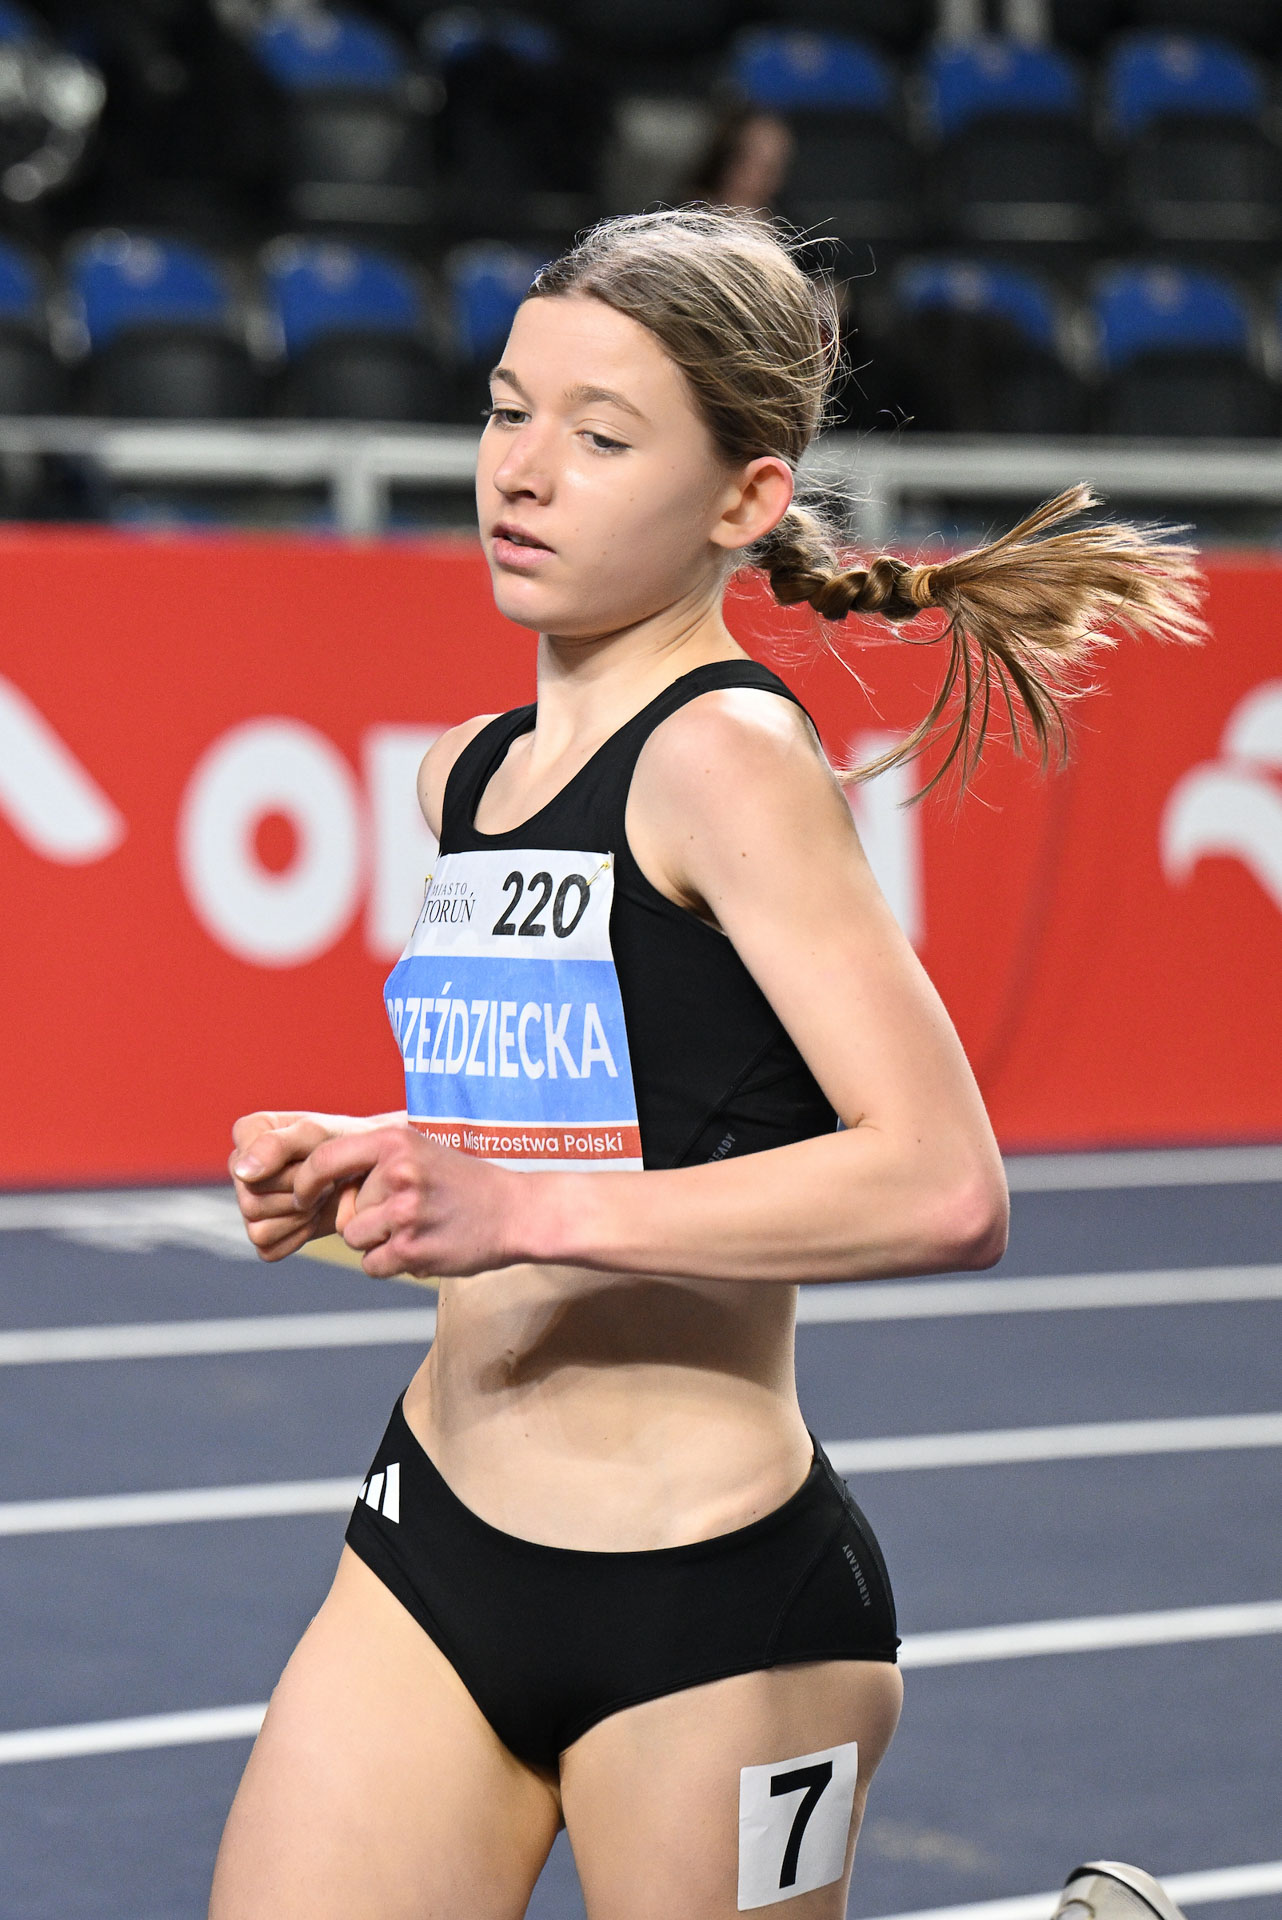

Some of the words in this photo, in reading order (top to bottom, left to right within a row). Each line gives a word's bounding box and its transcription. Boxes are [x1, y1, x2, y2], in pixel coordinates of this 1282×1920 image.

[422, 891, 477, 923] TORUŃ
[432, 882, 468, 896] MIASTO
[491, 870, 591, 939] 220
[416, 1128, 461, 1148] lowe
[463, 1130, 559, 1153] Mistrzostwa
[564, 1132, 623, 1153] Polski
[842, 1544, 872, 1607] AEROREADY
[770, 1760, 833, 1889] 7
